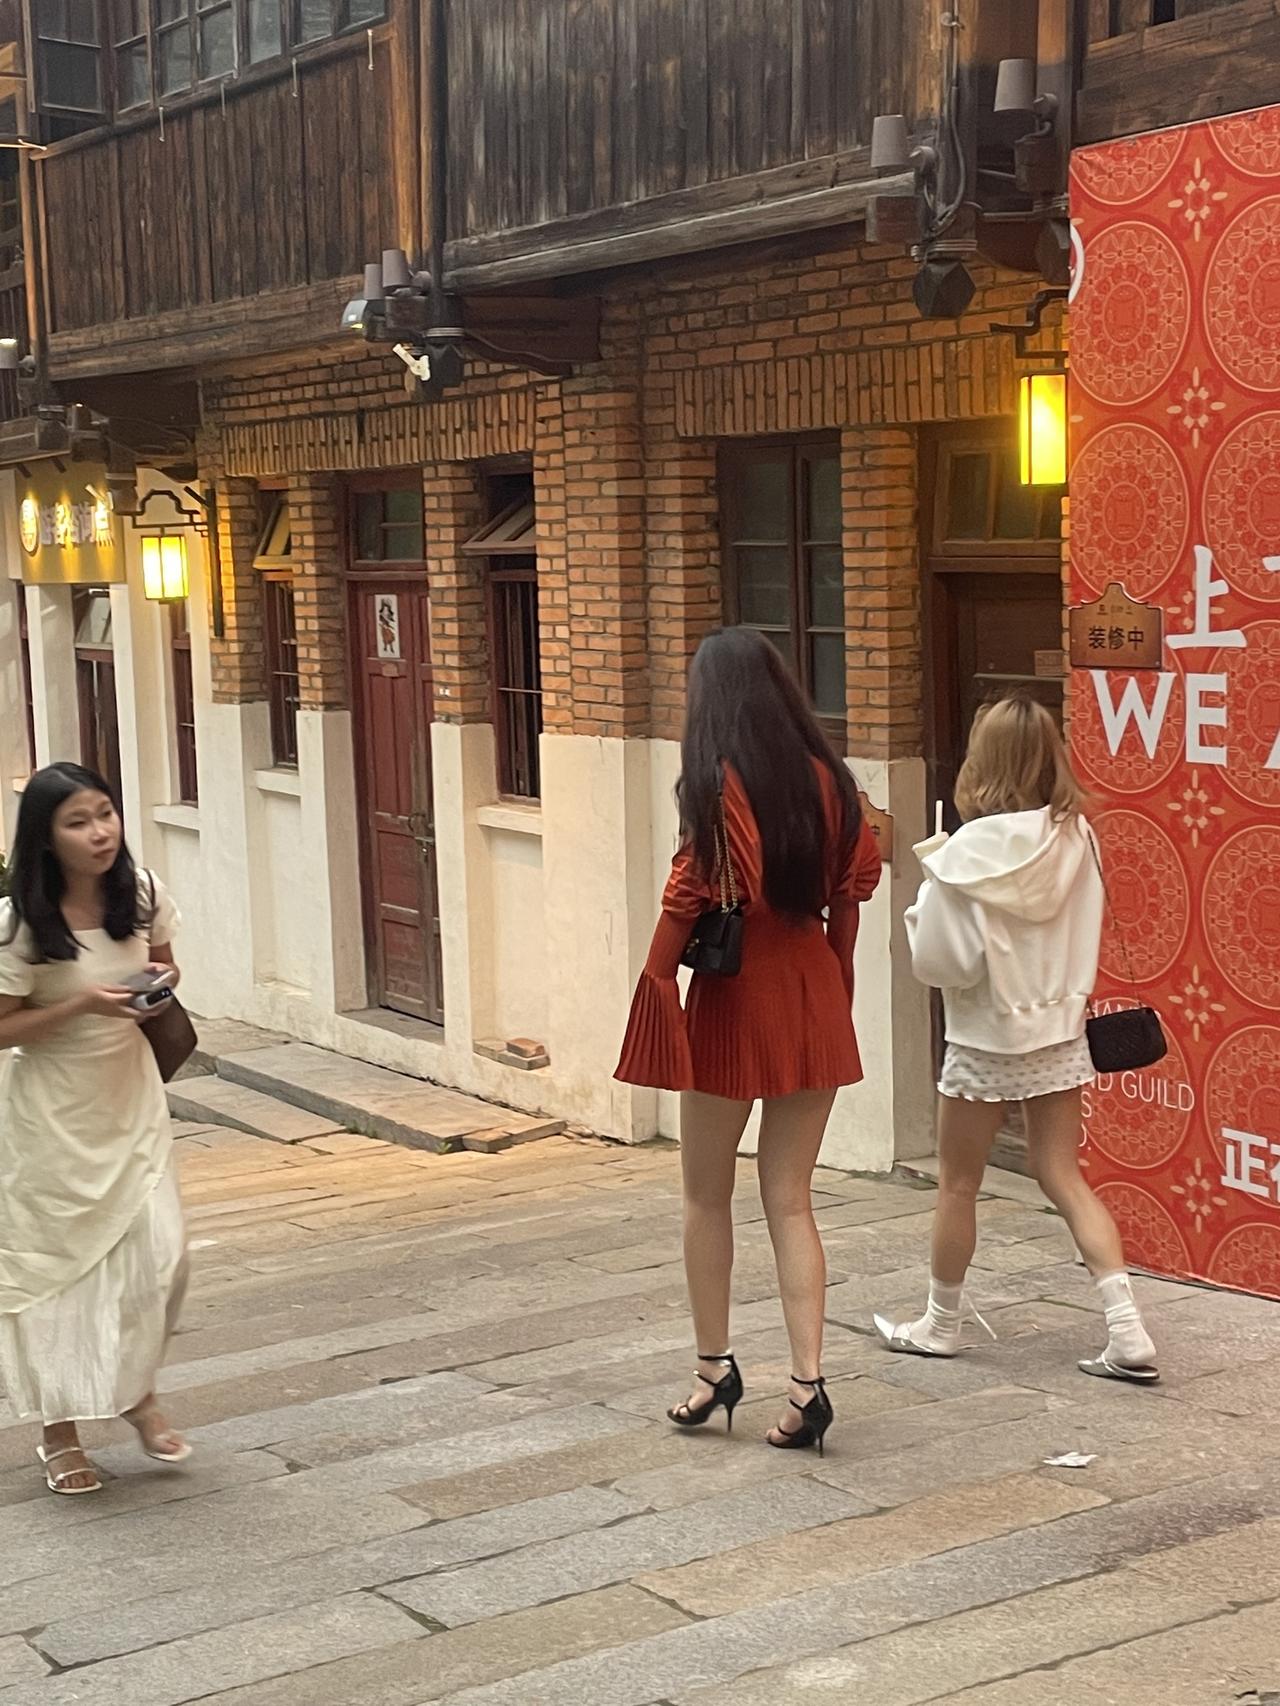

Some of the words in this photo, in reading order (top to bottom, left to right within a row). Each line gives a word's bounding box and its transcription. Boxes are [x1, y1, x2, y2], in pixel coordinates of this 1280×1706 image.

[1088, 625, 1144, 650] 装修中
[1090, 670, 1227, 768] WE
[1121, 1071, 1195, 1111] GUILD
[1220, 1127, 1280, 1203] 正
